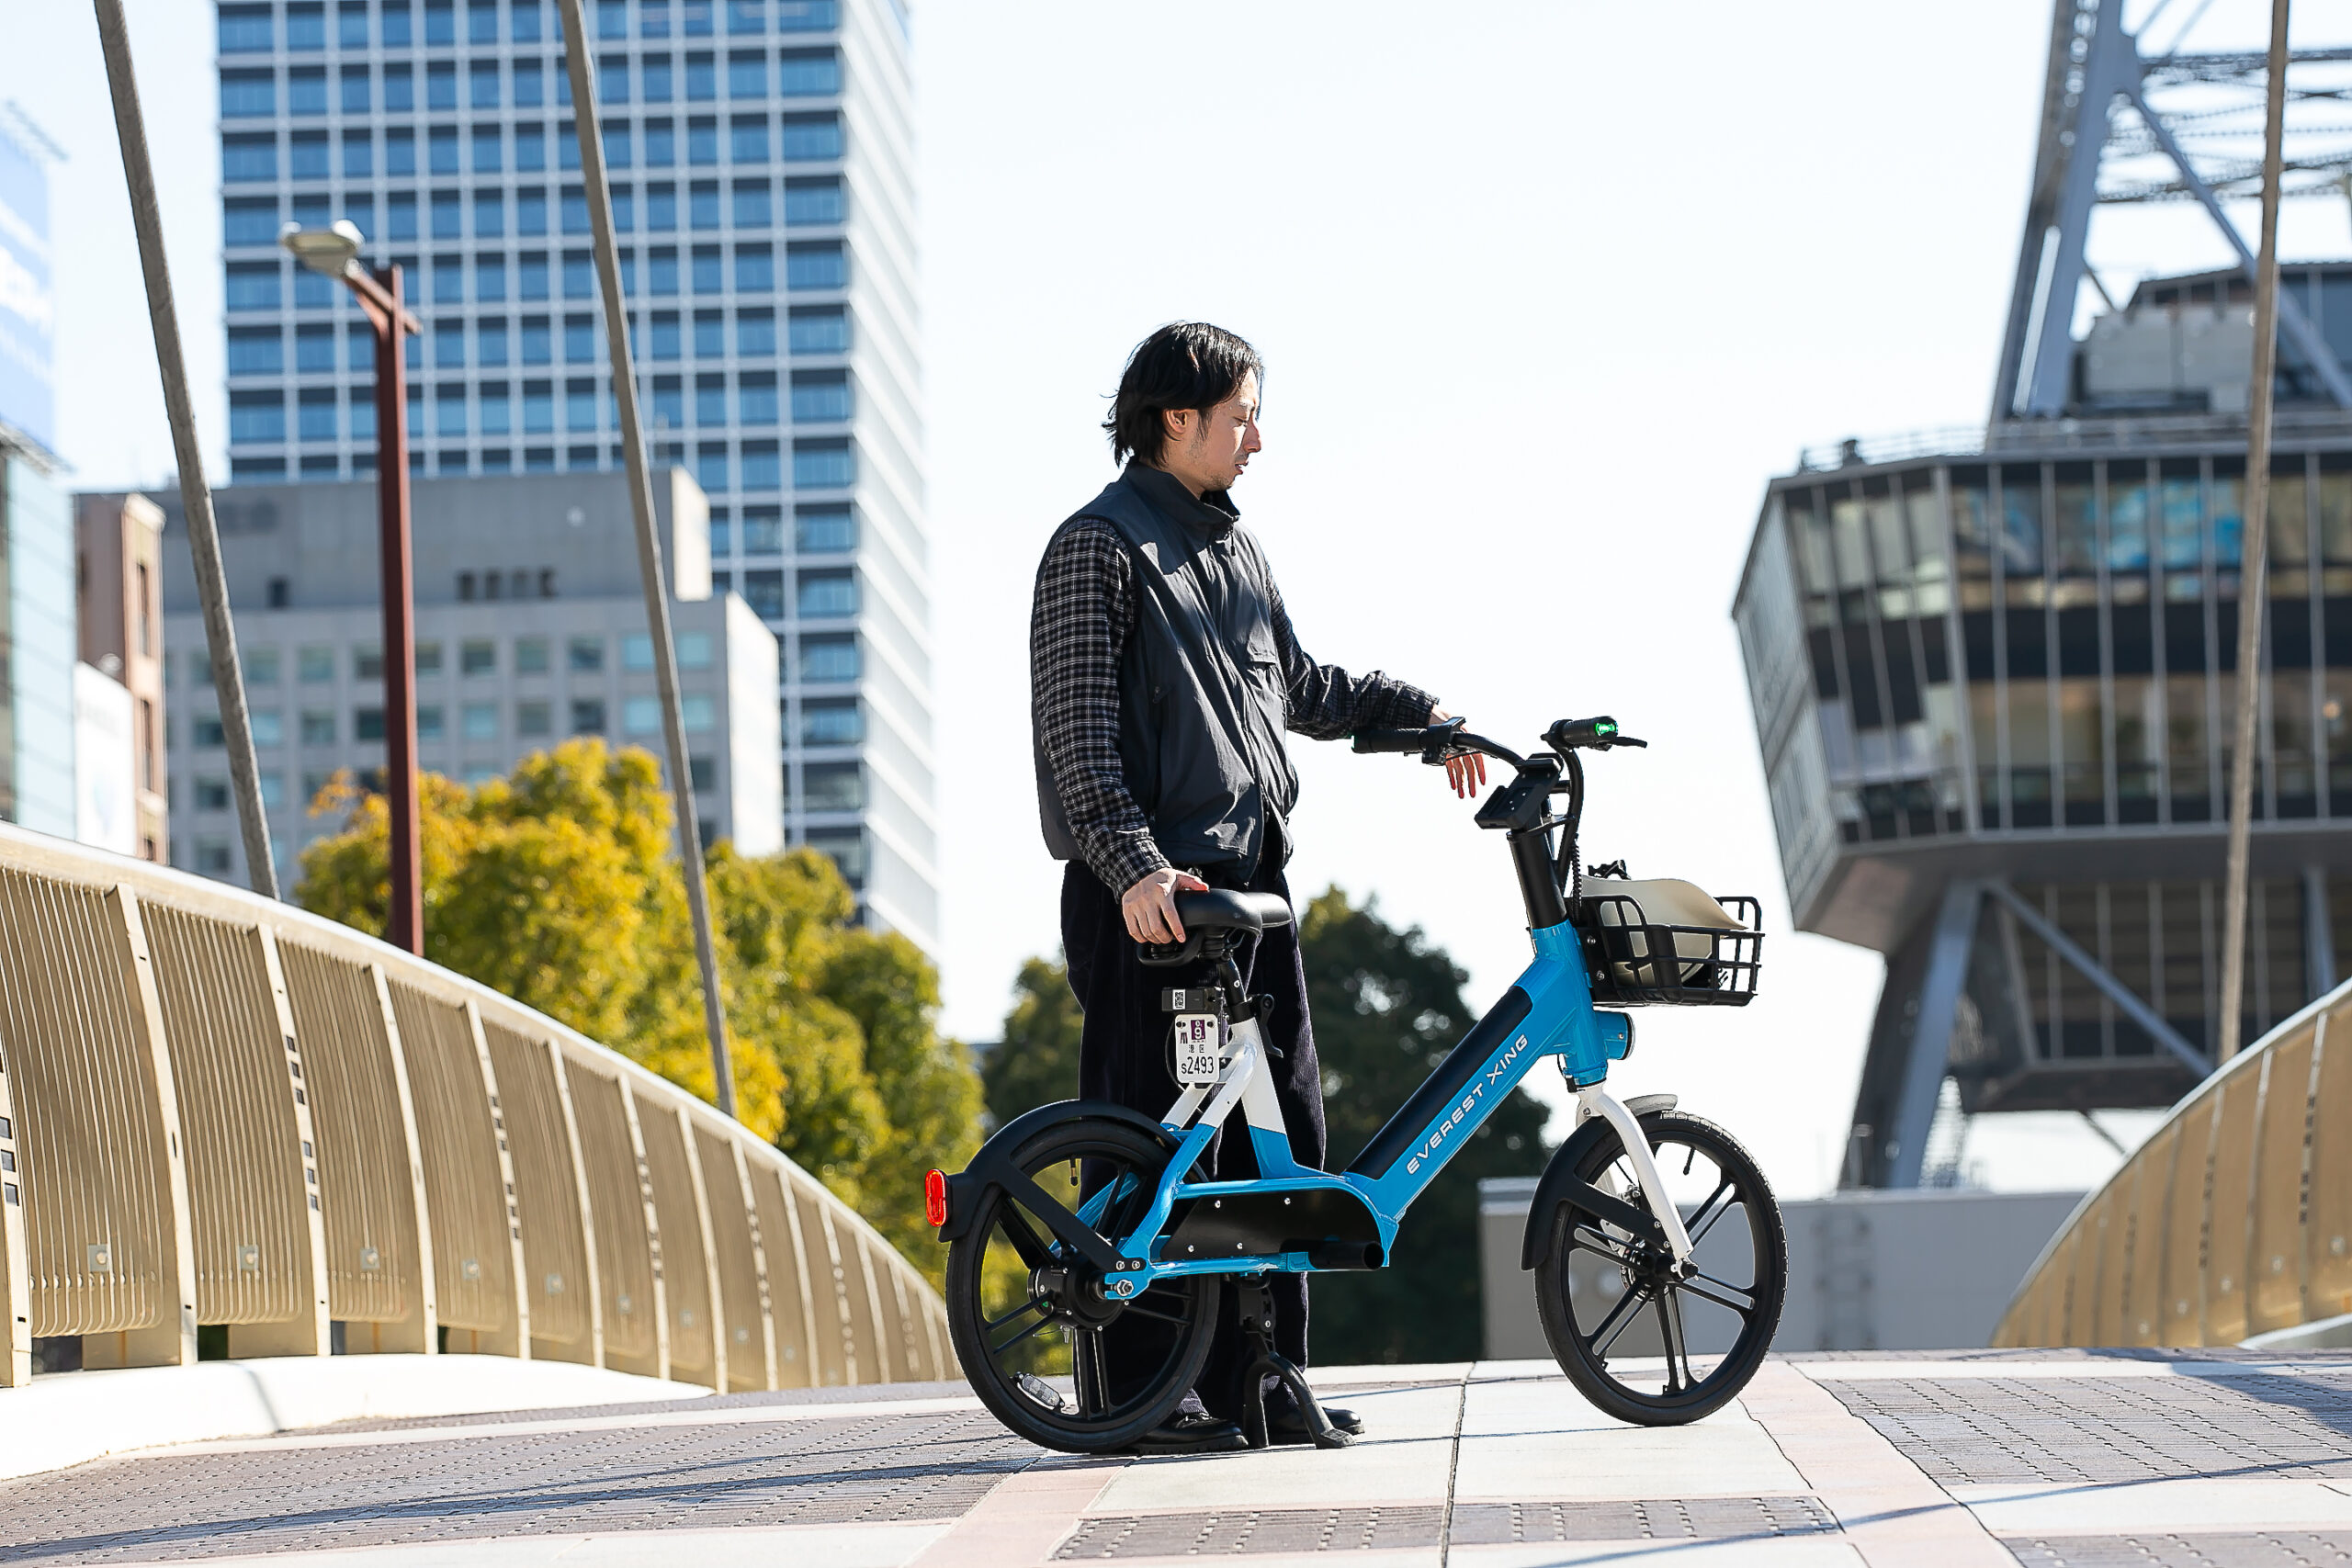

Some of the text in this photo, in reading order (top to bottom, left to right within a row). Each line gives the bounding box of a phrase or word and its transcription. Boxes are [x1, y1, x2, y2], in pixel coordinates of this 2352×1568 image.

[1194, 1027, 1202, 1040] 9
[1406, 1033, 1529, 1175] EVEREST XING
